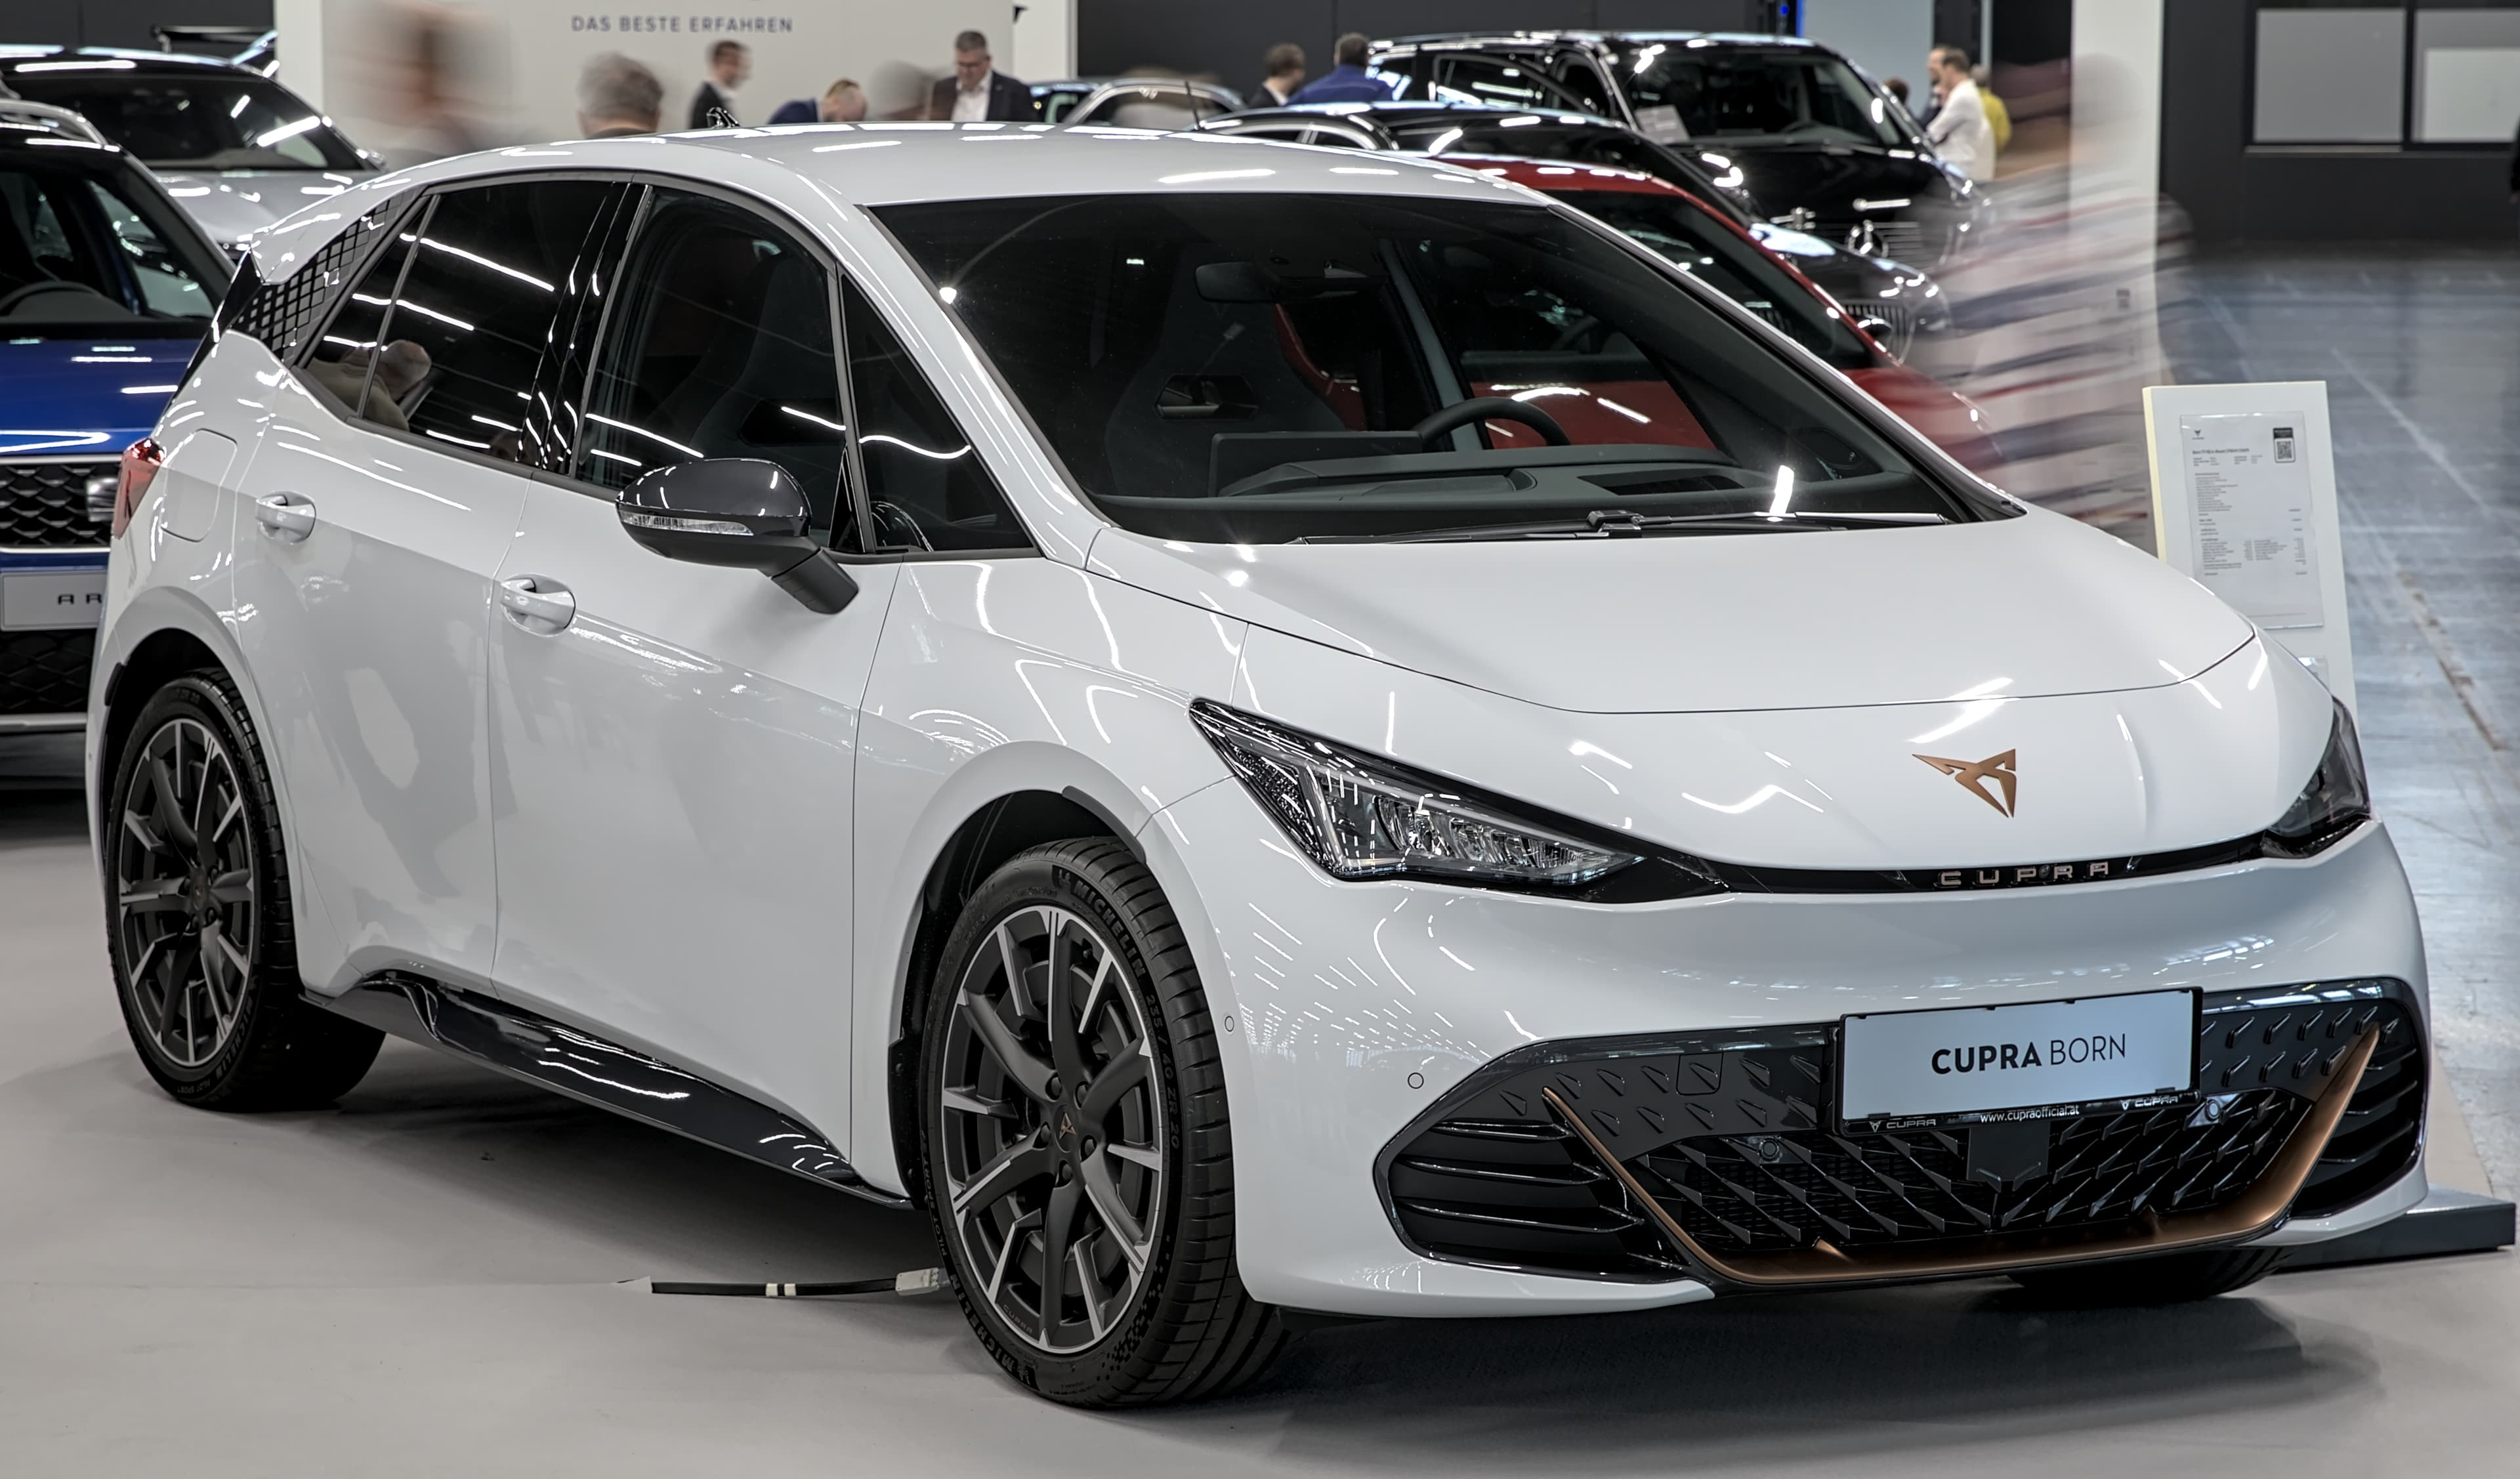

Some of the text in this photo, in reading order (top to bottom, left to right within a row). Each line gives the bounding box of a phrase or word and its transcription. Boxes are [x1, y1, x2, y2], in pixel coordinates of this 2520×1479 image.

[570, 15, 793, 33] DAS BESTE ERFAHREN
[1940, 862, 2109, 886] CUPRA
[1073, 879, 1146, 978] MICHELIN
[1146, 995, 1164, 1029] 235
[1162, 1053, 1173, 1080] 40
[1170, 1120, 1180, 1150] 20
[1931, 1033, 2126, 1075] CUPRA BORN
[1886, 1096, 2178, 1129] CUPRA www.cupraofficial.at CUPRA
[933, 1214, 949, 1257] PILOT
[950, 1273, 1016, 1372] MICHELIN
[1003, 1304, 1033, 1333] CUPRA
